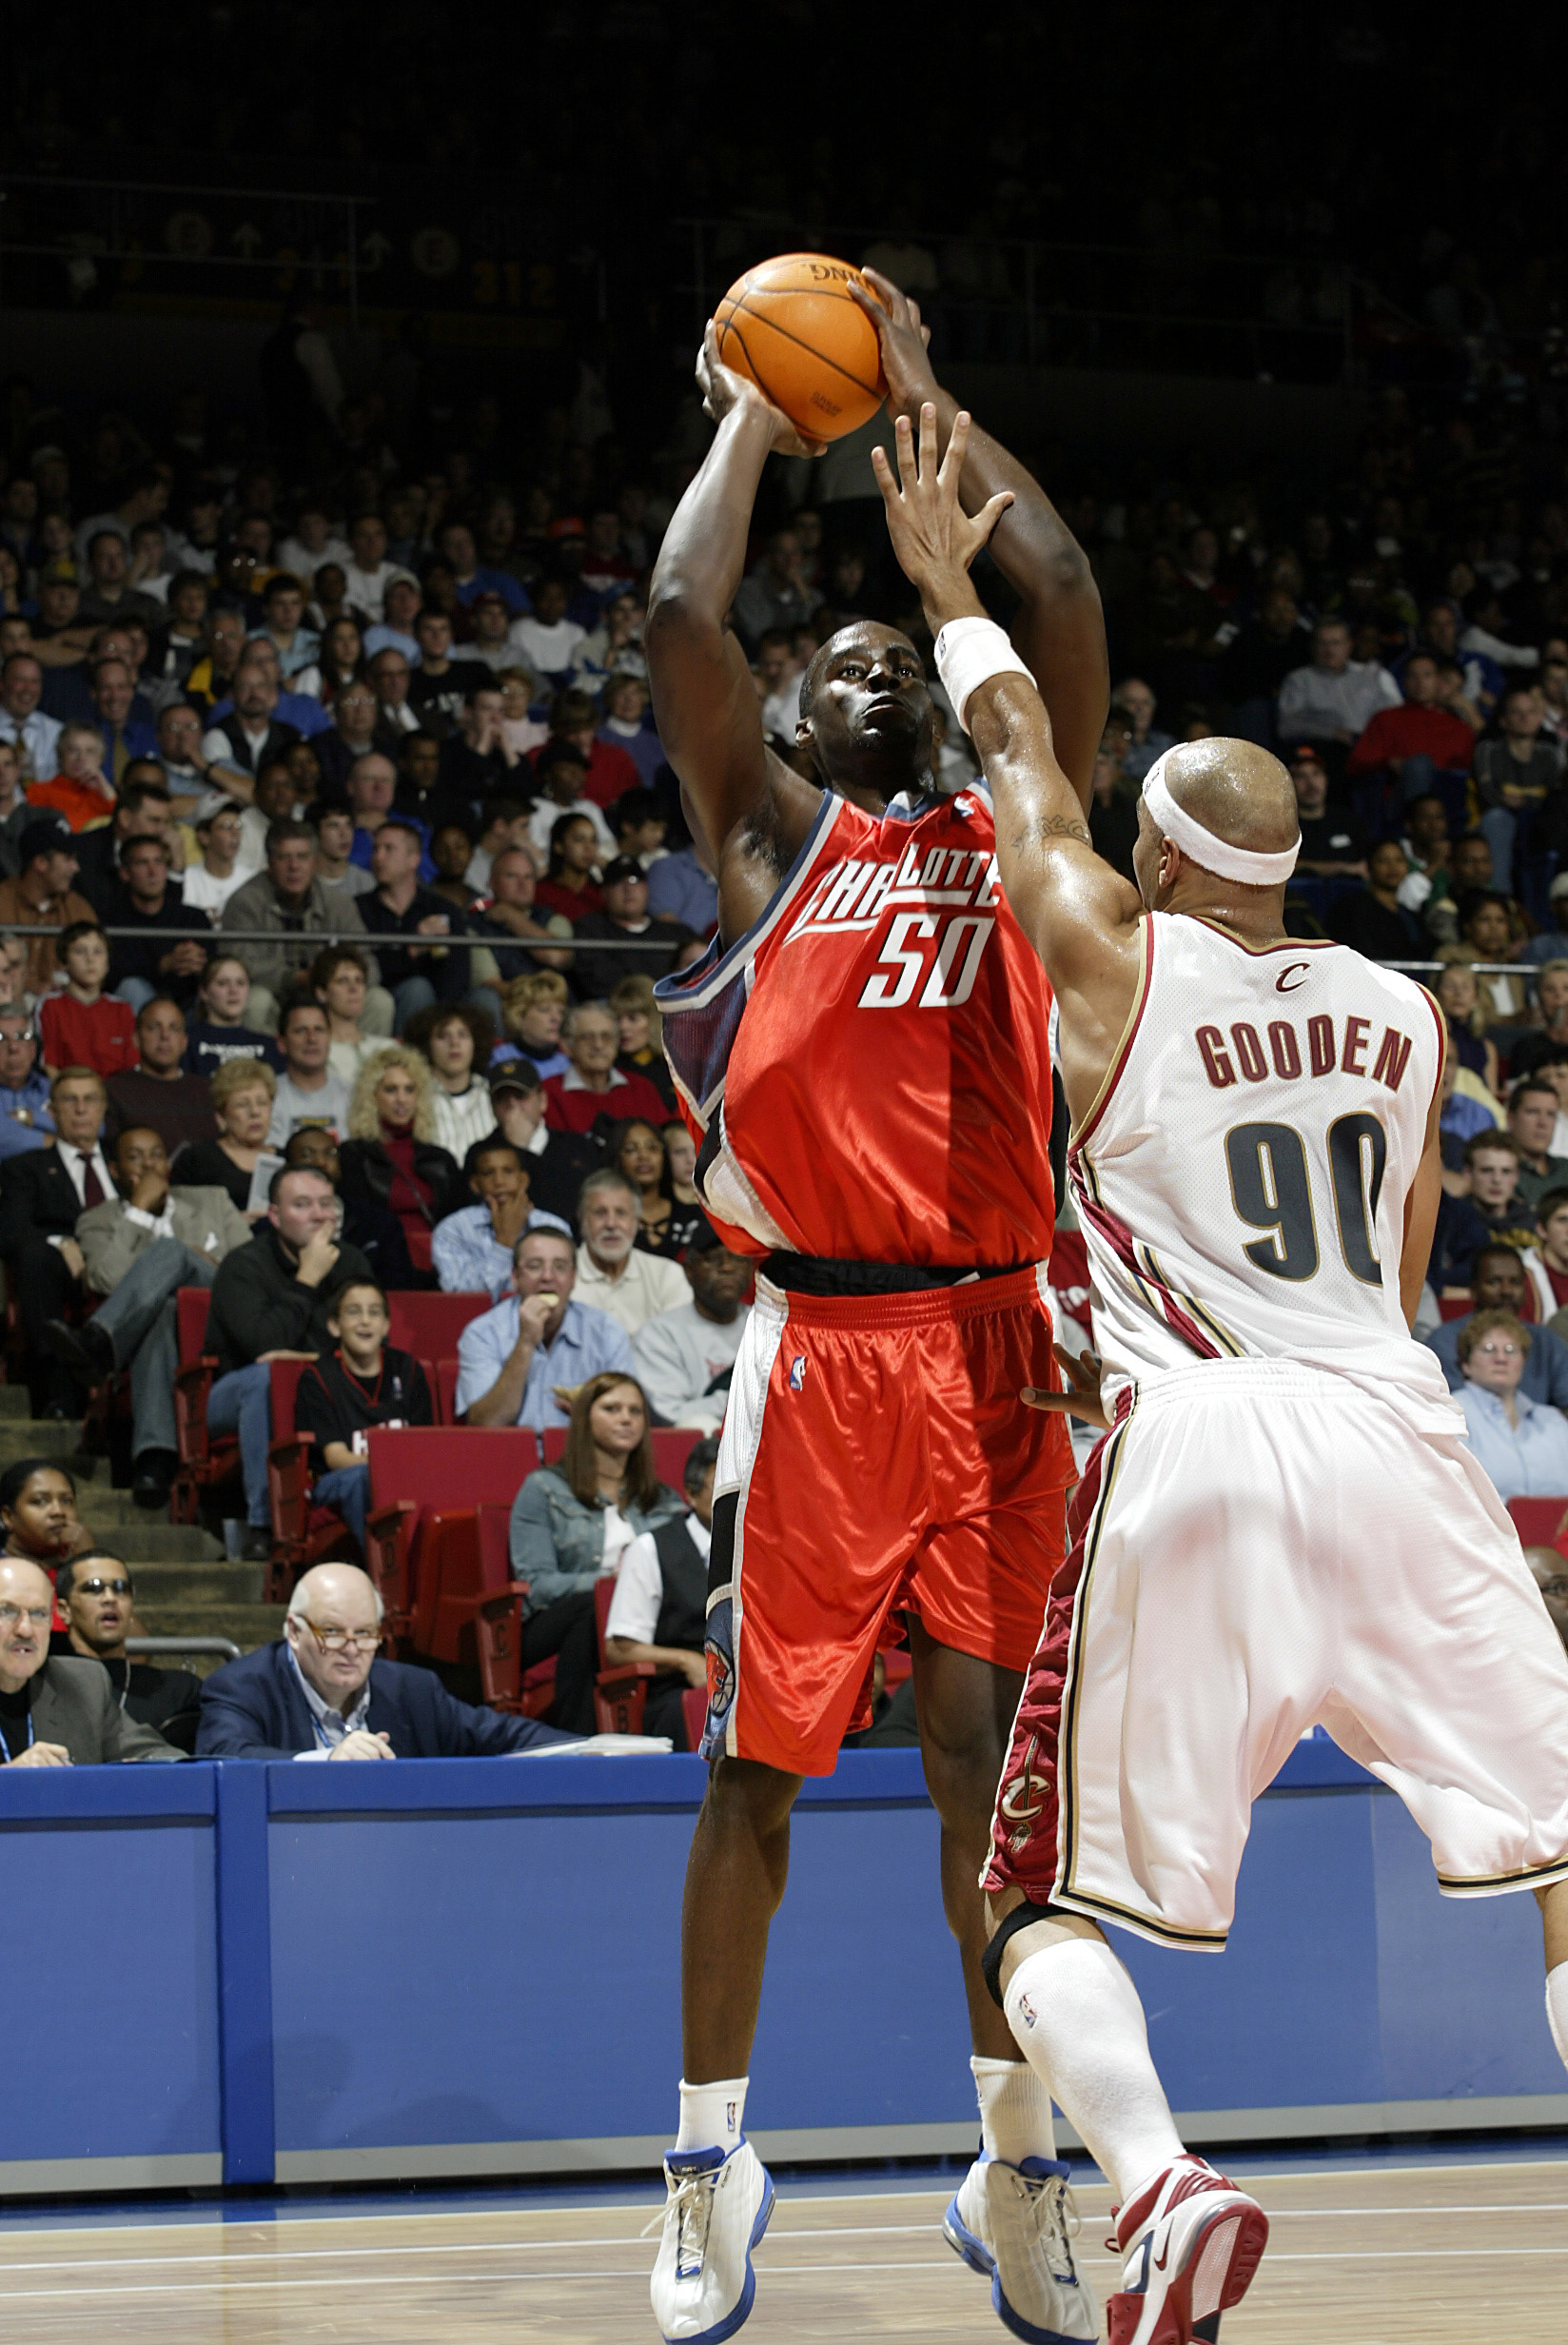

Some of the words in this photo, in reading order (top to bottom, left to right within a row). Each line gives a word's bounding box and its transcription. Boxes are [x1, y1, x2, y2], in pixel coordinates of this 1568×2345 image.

[782, 843, 1002, 949] CHALOTTE
[858, 912, 995, 1008] 50
[1195, 1014, 1412, 1093] GOODEN
[1224, 1111, 1387, 1286] 90
